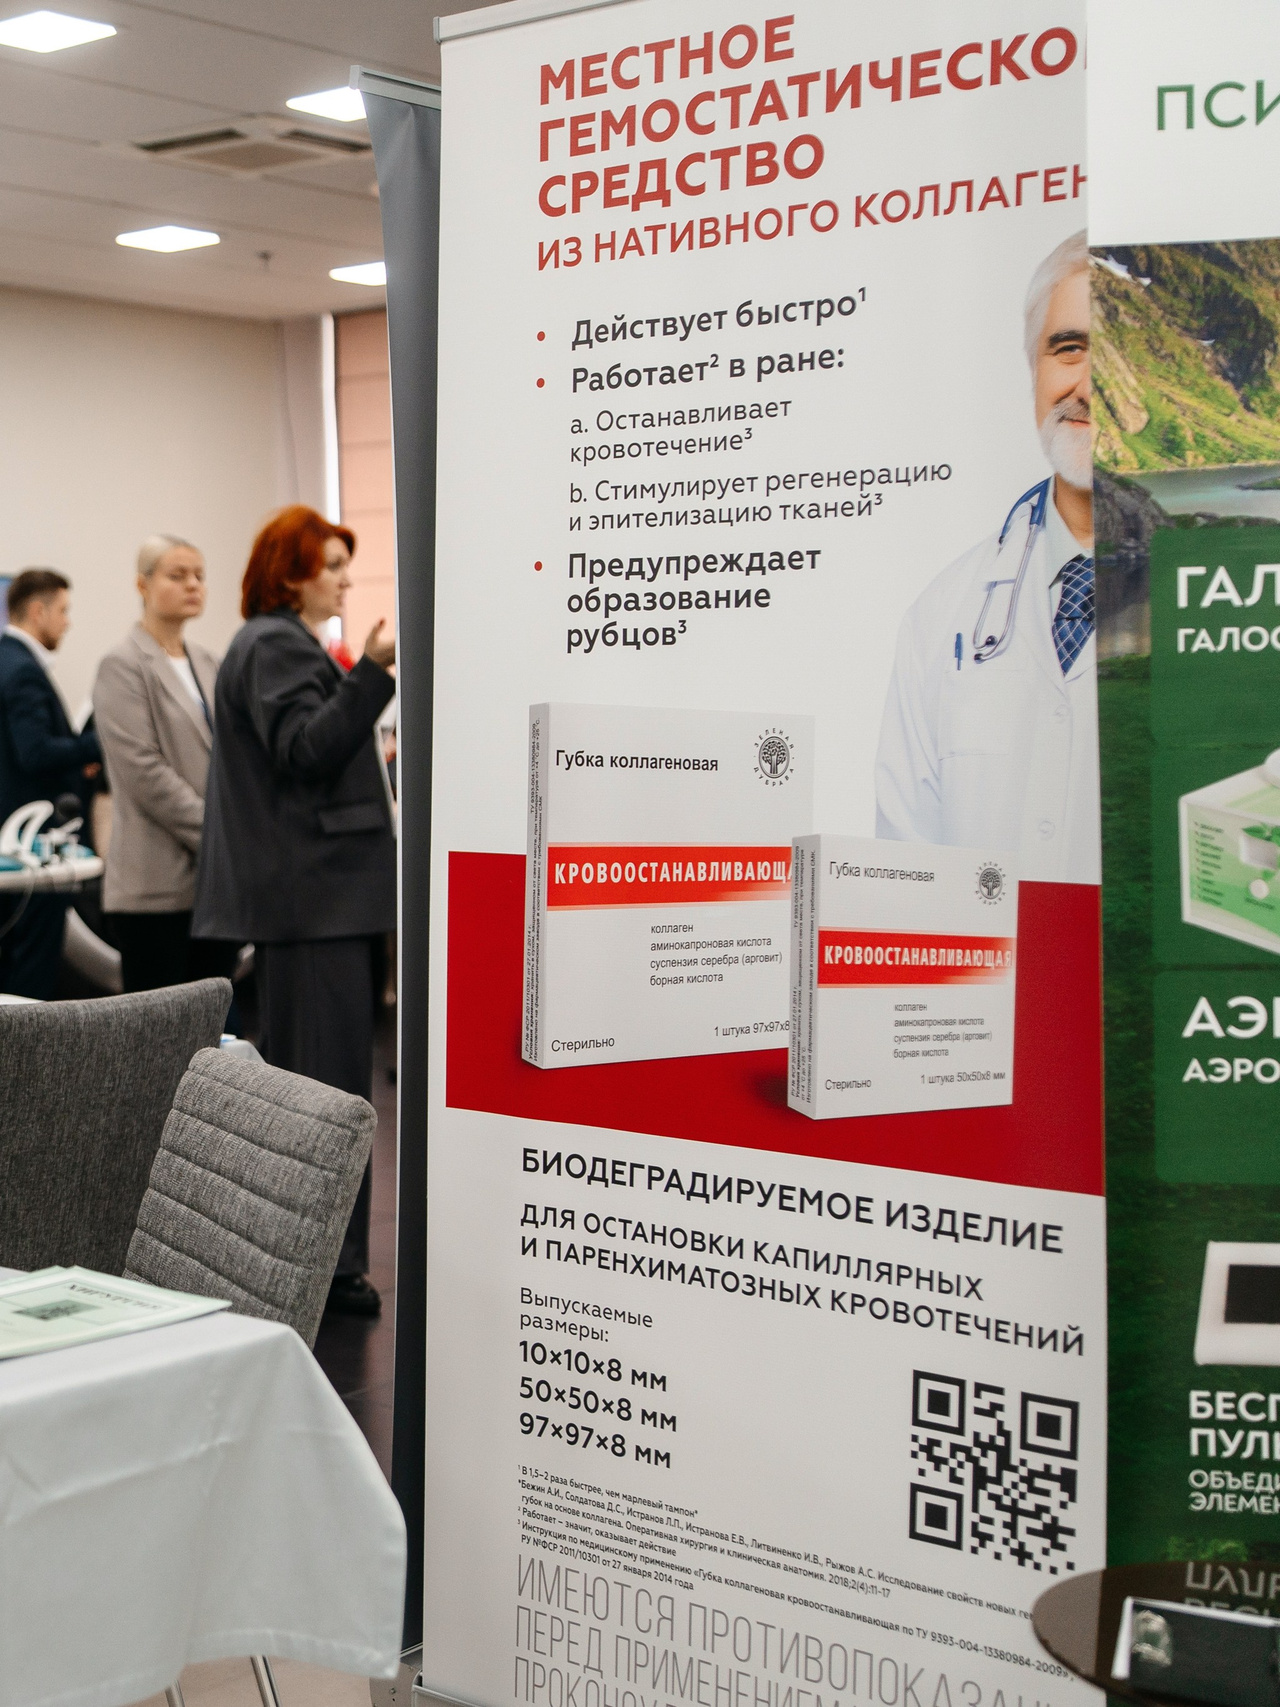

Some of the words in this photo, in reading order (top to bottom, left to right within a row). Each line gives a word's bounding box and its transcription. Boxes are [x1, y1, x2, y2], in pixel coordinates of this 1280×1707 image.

[541, 14, 794, 105] МЕСТНОЕ
[539, 26, 1087, 162] ГЕМОСТАТИЧЕСКО
[539, 134, 824, 218] СРЕДСТВО
[539, 236, 582, 271] ИЗ
[595, 199, 839, 263] НАТИВНОГО
[572, 310, 727, 352] Действует
[730, 358, 745, 378] в
[757, 348, 843, 383] ране:
[597, 401, 791, 431] Останавливает
[596, 476, 758, 504] Стимулирует
[766, 464, 951, 497] регенерацию
[570, 516, 580, 531] и
[589, 506, 771, 530] эпителизацию
[569, 550, 821, 585] Предупреждает
[568, 587, 770, 618] образование
[556, 750, 603, 771] Губка
[611, 756, 717, 771] коллагеновая
[830, 861, 860, 879] Губка
[864, 867, 934, 882] коллагеновая
[651, 925, 693, 933] коллаген
[651, 940, 733, 952] аминокапроновая
[737, 938, 771, 947] кислота
[650, 958, 698, 971] суспензия
[701, 954, 738, 967] серебра
[742, 952, 782, 966] (арговит)
[824, 944, 1012, 970] КРОВООСТАНАВЛИВАЮЩАЯ
[650, 974, 683, 988] борная
[687, 974, 723, 984] кислота
[715, 1026, 718, 1036] 1
[723, 1025, 750, 1038] штука
[1181, 995, 1280, 1039] АЭ
[552, 1038, 614, 1053] Стерильно
[825, 1079, 871, 1092] Стерильно
[929, 1074, 954, 1086] штука
[993, 1072, 1005, 1080] мм
[523, 1148, 873, 1225] БИОДЕГРАДИРУЕМОЕ
[886, 1200, 1062, 1254] ИЗДЕЛИЕ
[521, 1203, 574, 1231] ДЛЯ
[584, 1212, 743, 1259] ОСТАНОВКИ
[754, 1240, 983, 1301] КАПИЛЛЯРНЫХ
[521, 1287, 652, 1328] Выпускаемые
[522, 1236, 536, 1258] И
[547, 1239, 821, 1309] ПАРЕНХИМАТОЗНЫХ
[831, 1289, 1083, 1356] КРОВОТЕЧЕНИЙ
[521, 1314, 608, 1342] размеры:
[632, 1369, 666, 1392] мм
[641, 1409, 676, 1432] мм
[636, 1445, 670, 1469] мм
[550, 1474, 568, 1486] раза
[570, 1477, 603, 1495] быстрее,
[606, 1488, 620, 1498] чем
[622, 1492, 663, 1509] марлевый
[522, 1496, 543, 1508] губок
[544, 1502, 552, 1511] на
[554, 1504, 580, 1518] основе
[582, 1511, 623, 1529] коллагена.
[625, 1520, 678, 1543] Оперативная
[680, 1537, 718, 1553] хирургия
[727, 1549, 782, 1570] клиническая
[783, 1563, 827, 1581] анатомия.
[523, 1508, 556, 1526] Работает
[565, 1521, 593, 1536] значит,
[595, 1528, 637, 1546] оказывает
[639, 1540, 676, 1556] действие
[522, 1533, 531, 1545] РУ
[560, 1545, 600, 1564] 2011/10301
[602, 1558, 610, 1566] от
[612, 1559, 621, 1569] 27
[623, 1564, 651, 1579] января
[654, 1570, 672, 1583] 2014
[675, 1579, 693, 1590] года
[547, 1486, 563, 1501] А.И.,
[565, 1491, 605, 1510] Солдатова
[607, 1501, 624, 1516] Д.С.,
[626, 1506, 664, 1525] Истранов
[666, 1516, 683, 1531] Л.П.,
[685, 1521, 729, 1541] Истранова
[731, 1532, 748, 1547] Е.В.,
[750, 1537, 802, 1559] Литвиненко
[804, 1551, 824, 1566] И.В.,
[826, 1556, 856, 1573] Рыжов
[858, 1565, 875, 1578] А.С.
[878, 1570, 944, 1597] Исследование
[947, 1591, 983, 1607] свойств
[986, 1601, 1015, 1616] новых
[517, 1553, 675, 1642] ИМЕЮТСЯ
[522, 1521, 566, 1542] Инструкция
[569, 1535, 578, 1545] по
[579, 1538, 638, 1561] медицинскому
[640, 1554, 692, 1575] применению
[694, 1566, 722, 1583] «Губка
[725, 1576, 786, 1599] коллагеновая
[788, 1593, 899, 1631] кровоостанавливающая
[903, 1625, 913, 1634] по
[916, 1626, 928, 1639] ТУ
[515, 1604, 604, 1679] ПЕРЕД
